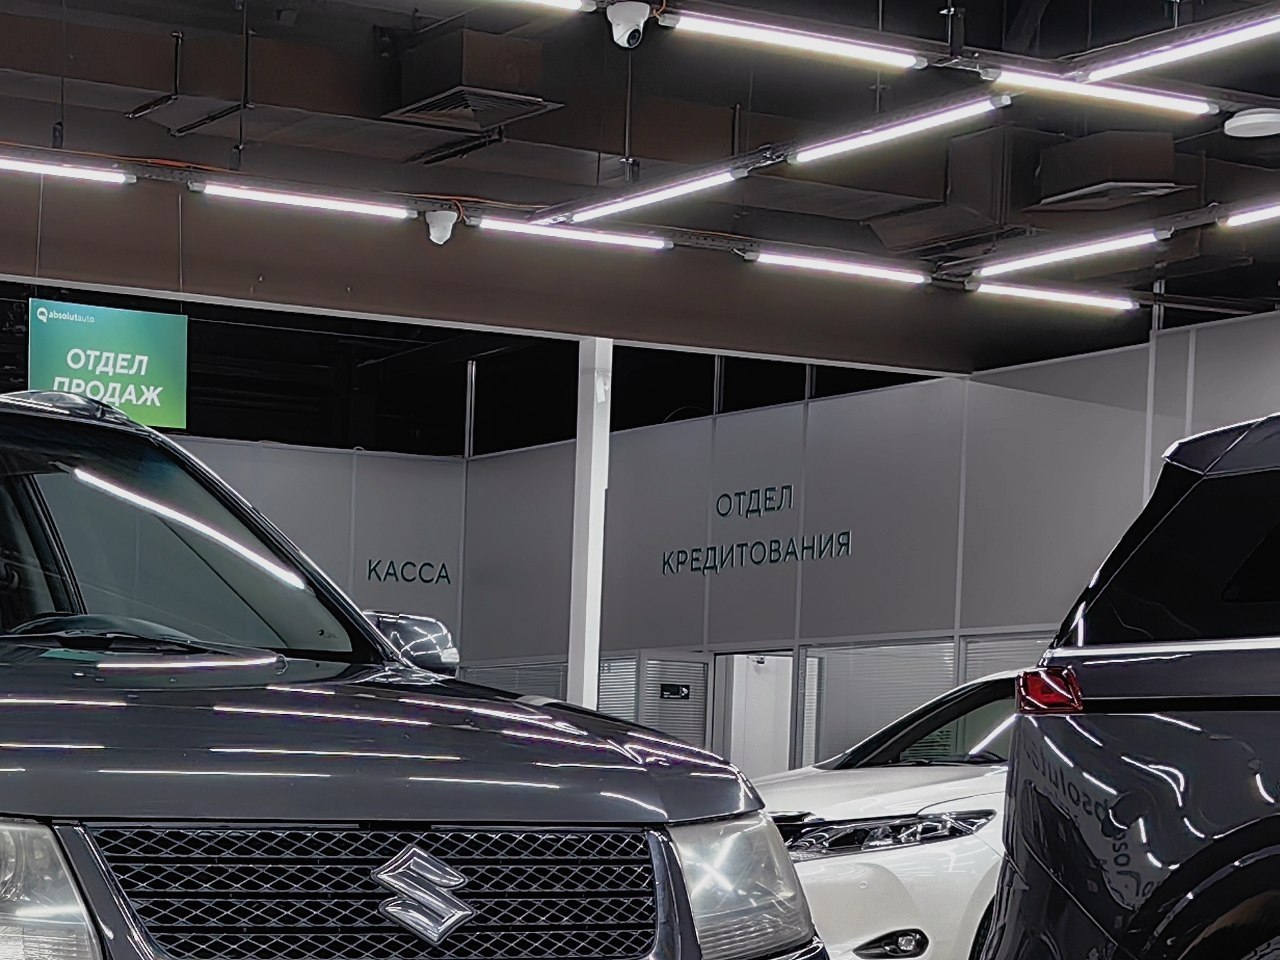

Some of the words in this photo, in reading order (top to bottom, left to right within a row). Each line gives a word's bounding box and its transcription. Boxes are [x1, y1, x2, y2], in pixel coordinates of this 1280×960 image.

[48, 309, 95, 323] absolutauto
[66, 348, 149, 377] ОТДЕЛ
[53, 376, 163, 407] ПРОДАЖ
[716, 484, 794, 518] ОТДЕЛ
[662, 530, 852, 576] КРЕДИТОВАНИЯ
[367, 558, 451, 585] КАССА
